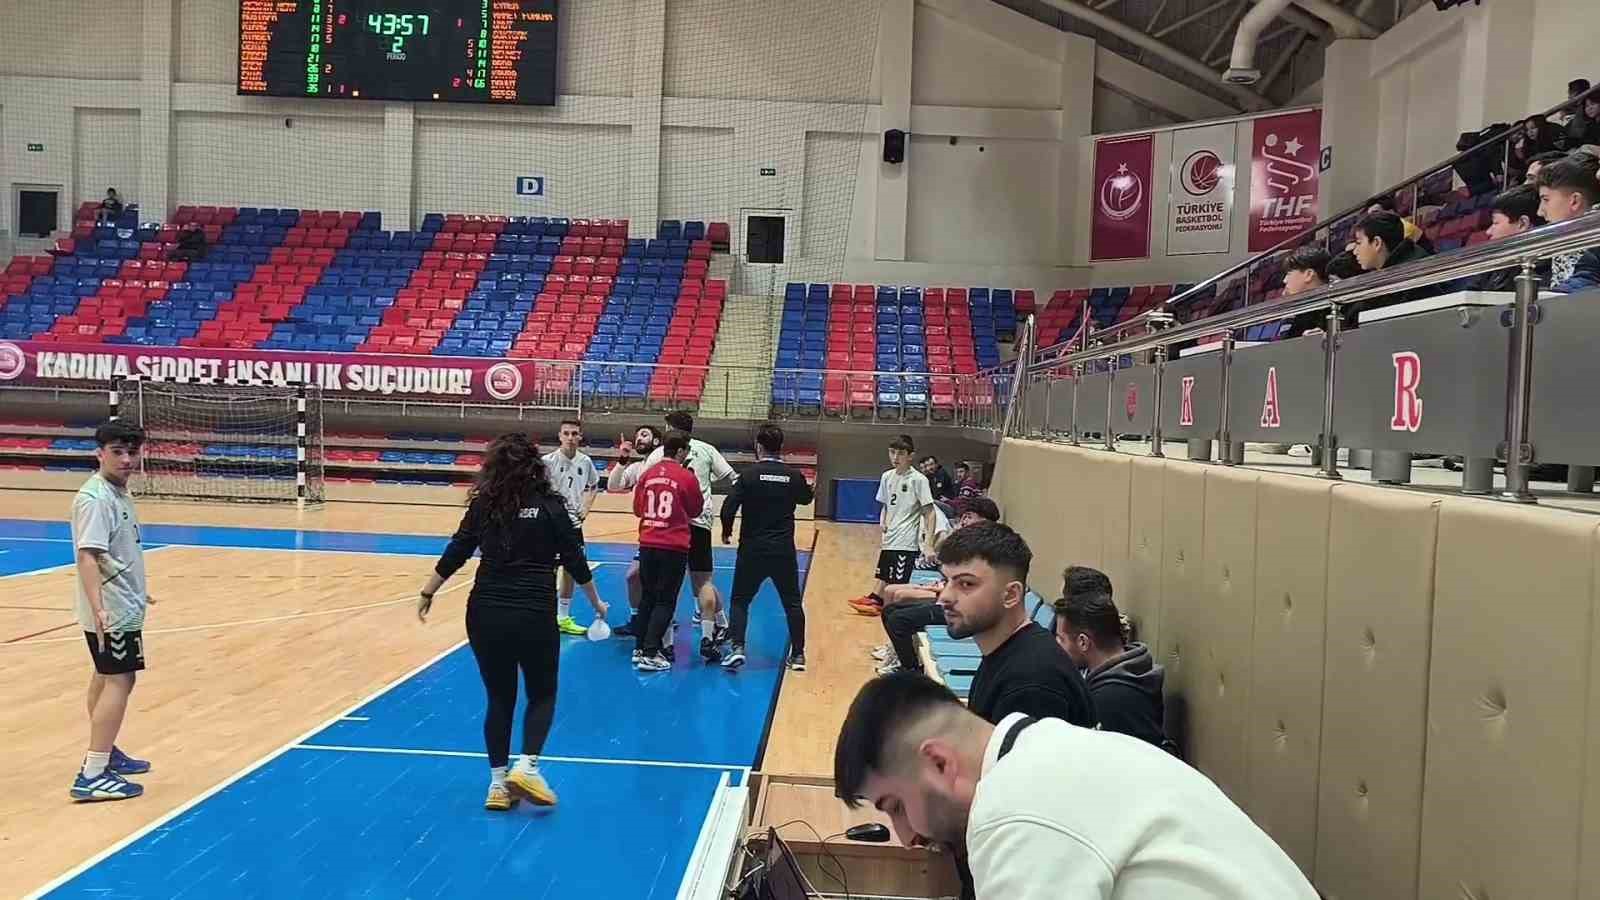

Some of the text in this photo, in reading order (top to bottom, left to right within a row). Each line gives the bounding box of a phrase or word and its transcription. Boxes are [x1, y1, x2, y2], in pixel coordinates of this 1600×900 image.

[338, 15, 346, 24] 2
[368, 14, 429, 35] 43:57
[325, 34, 333, 44] 5
[392, 36, 403, 52] 2
[307, 54, 319, 63] 21
[467, 49, 473, 57] 5
[478, 50, 486, 58] 11
[325, 64, 332, 73] 2
[452, 78, 460, 87] 2
[522, 178, 539, 193] D
[1177, 201, 1225, 215] TÜRKİYE
[1262, 194, 1313, 218] THF
[1176, 214, 1224, 224] BASKETBOL
[1175, 224, 1223, 232] FEDERASYONU
[36, 351, 131, 380] KADINA
[346, 362, 472, 395] SUÇUDUR!
[1180, 351, 1422, 433] K A R
[567, 476, 573, 489] 7
[644, 489, 674, 519] 18
[890, 493, 897, 506] 2
